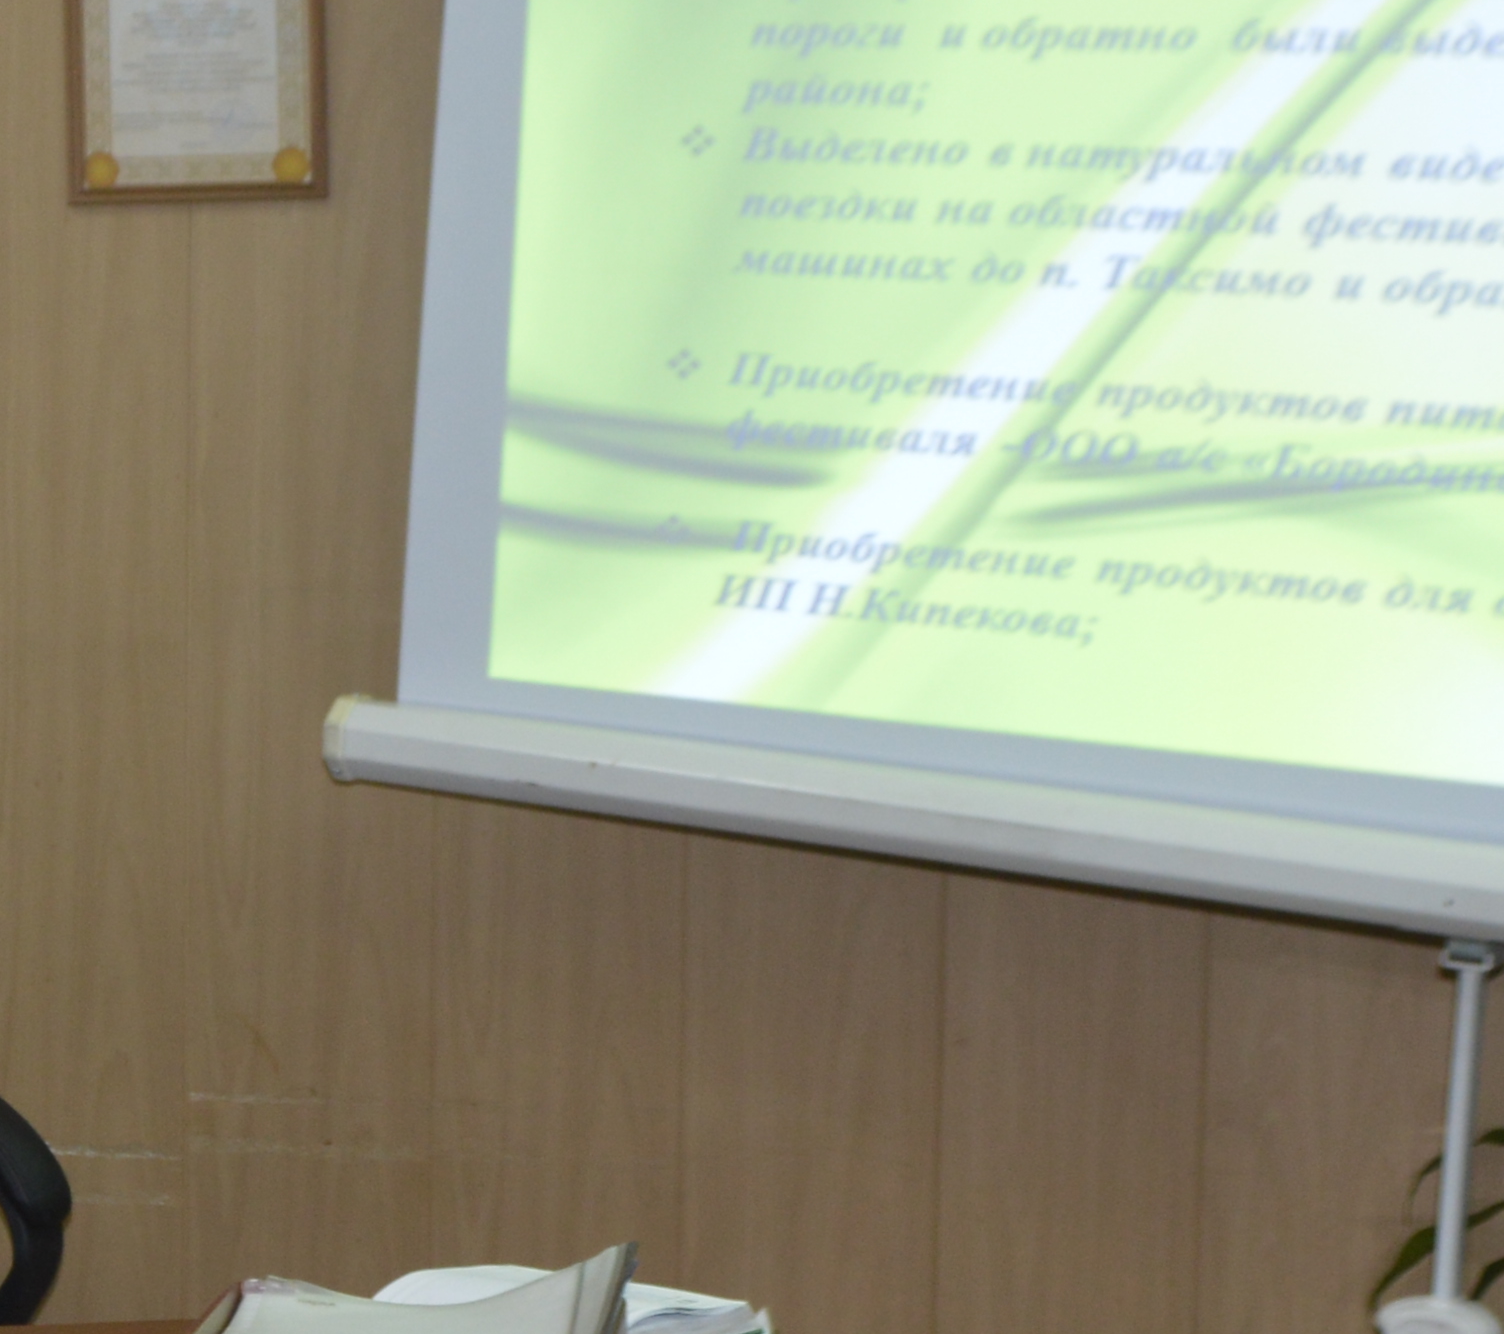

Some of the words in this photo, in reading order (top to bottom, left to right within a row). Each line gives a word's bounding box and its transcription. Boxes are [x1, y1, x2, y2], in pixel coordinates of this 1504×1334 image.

[740, 72, 930, 116] района;
[741, 123, 969, 166] Выделено
[988, 141, 1010, 168] в
[1026, 140, 1365, 185] натуральном
[739, 185, 918, 227] поездки
[935, 199, 992, 227] на
[1007, 198, 1280, 238] областной
[735, 244, 955, 282] машинах
[970, 252, 1024, 287] до
[1037, 260, 1079, 290] п.
[1098, 250, 1313, 301] Таксимо
[1332, 272, 1369, 302] и
[727, 351, 1079, 405] Приобретение
[1096, 373, 1368, 425] продуктов
[712, 574, 799, 617] ИП
[726, 517, 1077, 583] Приобретение
[1094, 553, 1368, 608] продуктов
[1383, 575, 1476, 616] для
